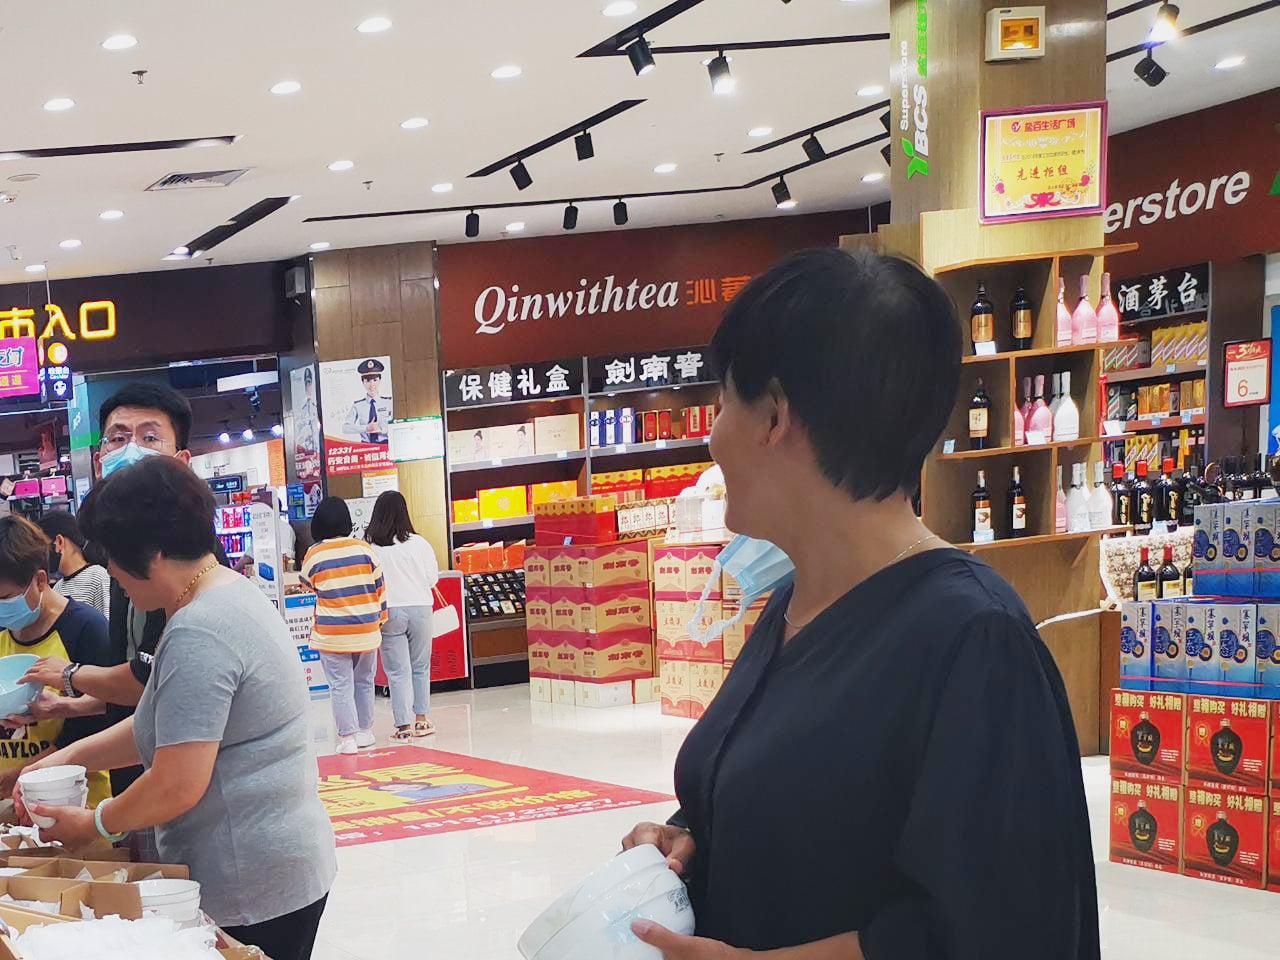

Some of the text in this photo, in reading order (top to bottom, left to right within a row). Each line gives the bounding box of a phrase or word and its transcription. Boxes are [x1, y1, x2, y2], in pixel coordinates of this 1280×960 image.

[900, 40, 910, 131] Superstore
[913, 84, 929, 157] BCS
[1103, 171, 1251, 234] erstore
[474, 275, 679, 335] Qinwithtea
[1117, 271, 1198, 313] 酒茅台
[458, 364, 570, 402] 保健礼盒
[1237, 379, 1248, 398] 6
